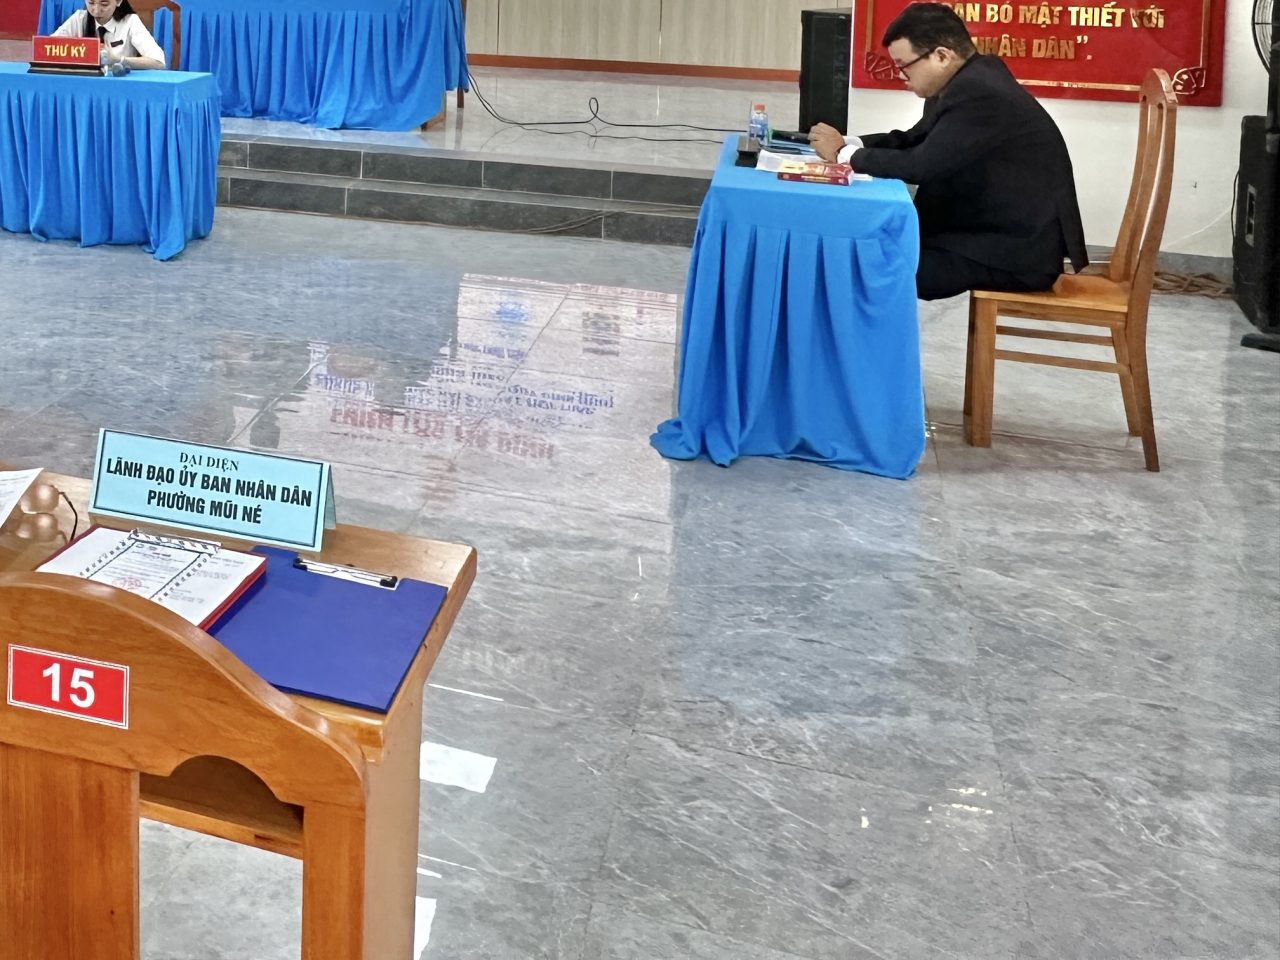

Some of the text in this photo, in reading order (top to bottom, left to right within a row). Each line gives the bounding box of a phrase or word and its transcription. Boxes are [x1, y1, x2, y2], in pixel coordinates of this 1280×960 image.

[44, 43, 86, 58] THƯ KÝ
[180, 452, 240, 472] ĐẠI DIỆN
[106, 457, 313, 507] LÃNH ĐẠO ỦY BAN NHÂN DÂN
[147, 489, 262, 524] PHƯỜNG MŨI NÉ
[41, 663, 97, 710] 15
